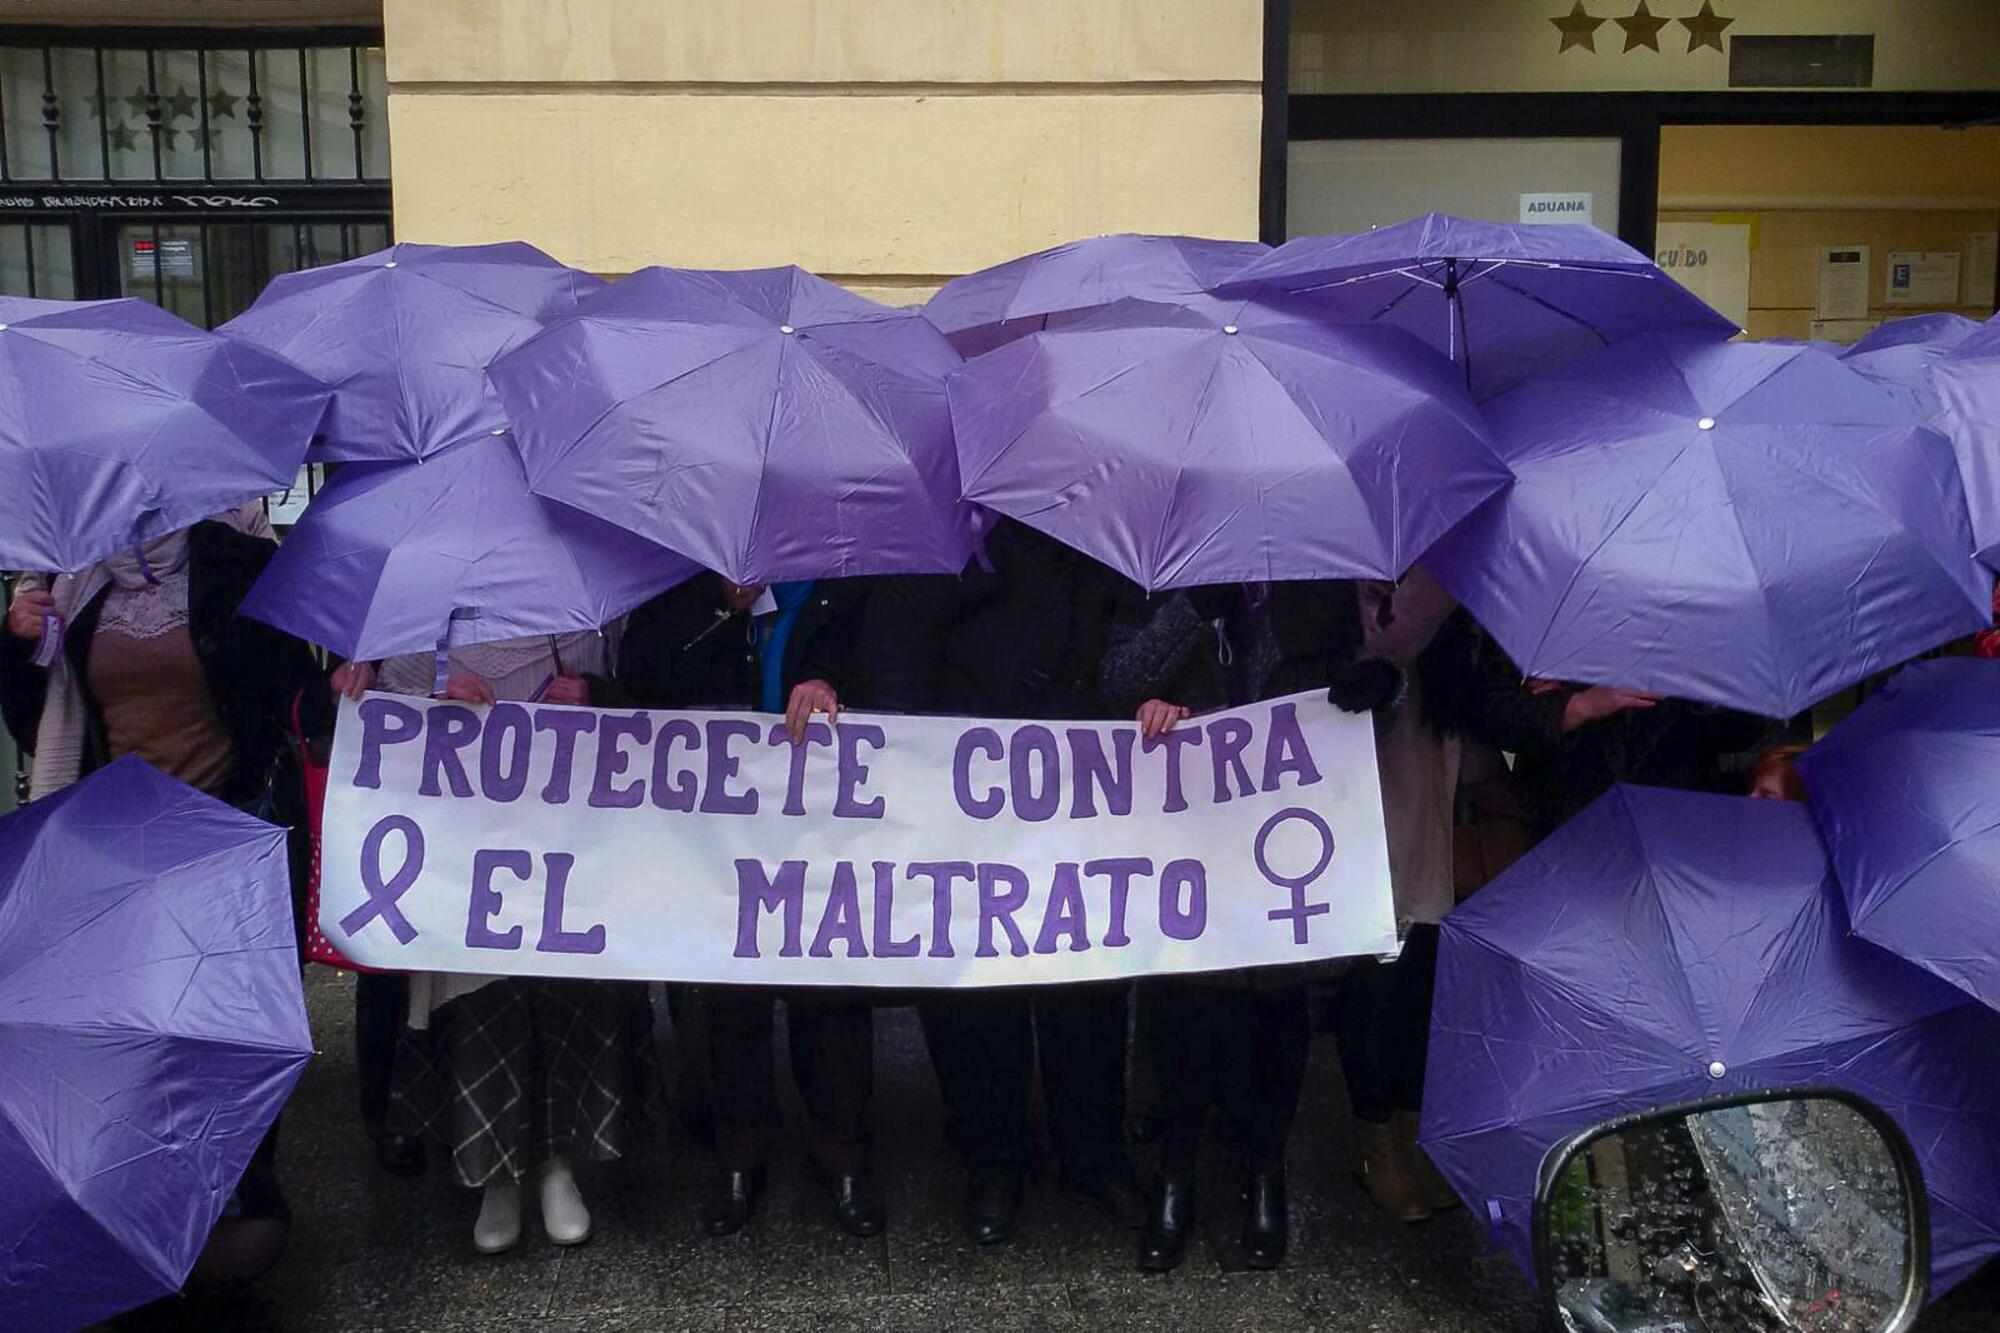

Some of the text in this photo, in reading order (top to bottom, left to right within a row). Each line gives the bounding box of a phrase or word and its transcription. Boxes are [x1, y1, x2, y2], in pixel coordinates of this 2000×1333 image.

[1528, 201, 1586, 213] ADUANA
[952, 702, 1323, 822] CONTRA
[465, 848, 1207, 958] EL MALTRATO
